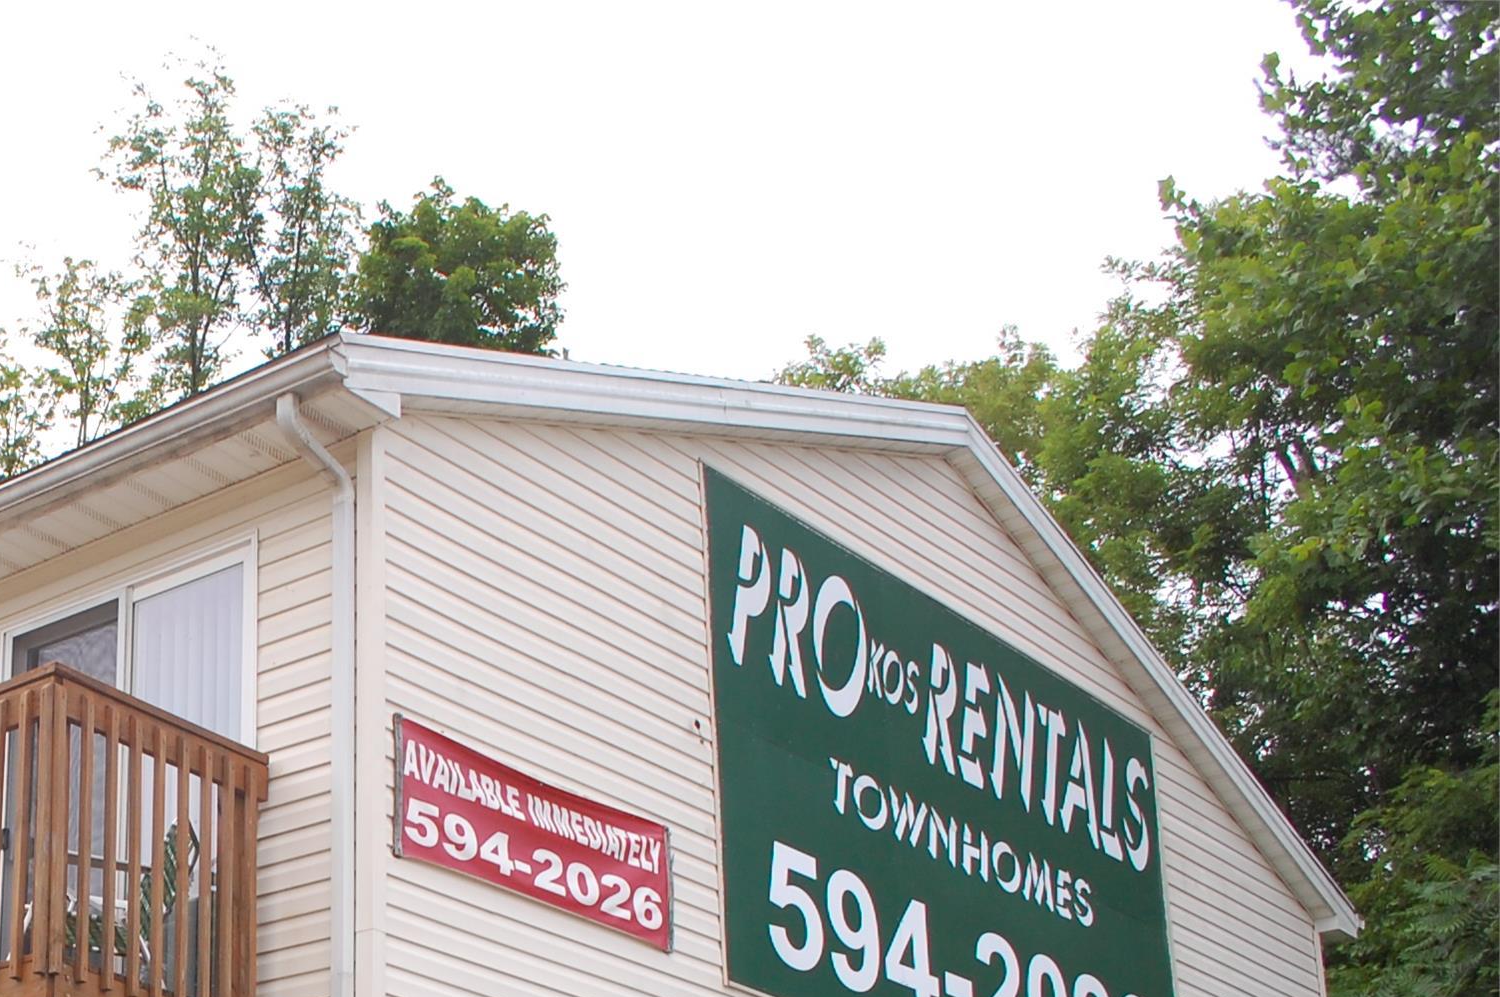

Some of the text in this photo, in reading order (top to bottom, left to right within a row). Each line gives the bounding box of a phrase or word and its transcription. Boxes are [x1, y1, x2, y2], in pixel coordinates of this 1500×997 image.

[404, 739, 661, 874] AVAILABLE IMMEDIATELY
[922, 642, 1149, 872] RENTALS
[404, 797, 663, 931] 594-2026
[830, 757, 1094, 927] TOWNHOMES
